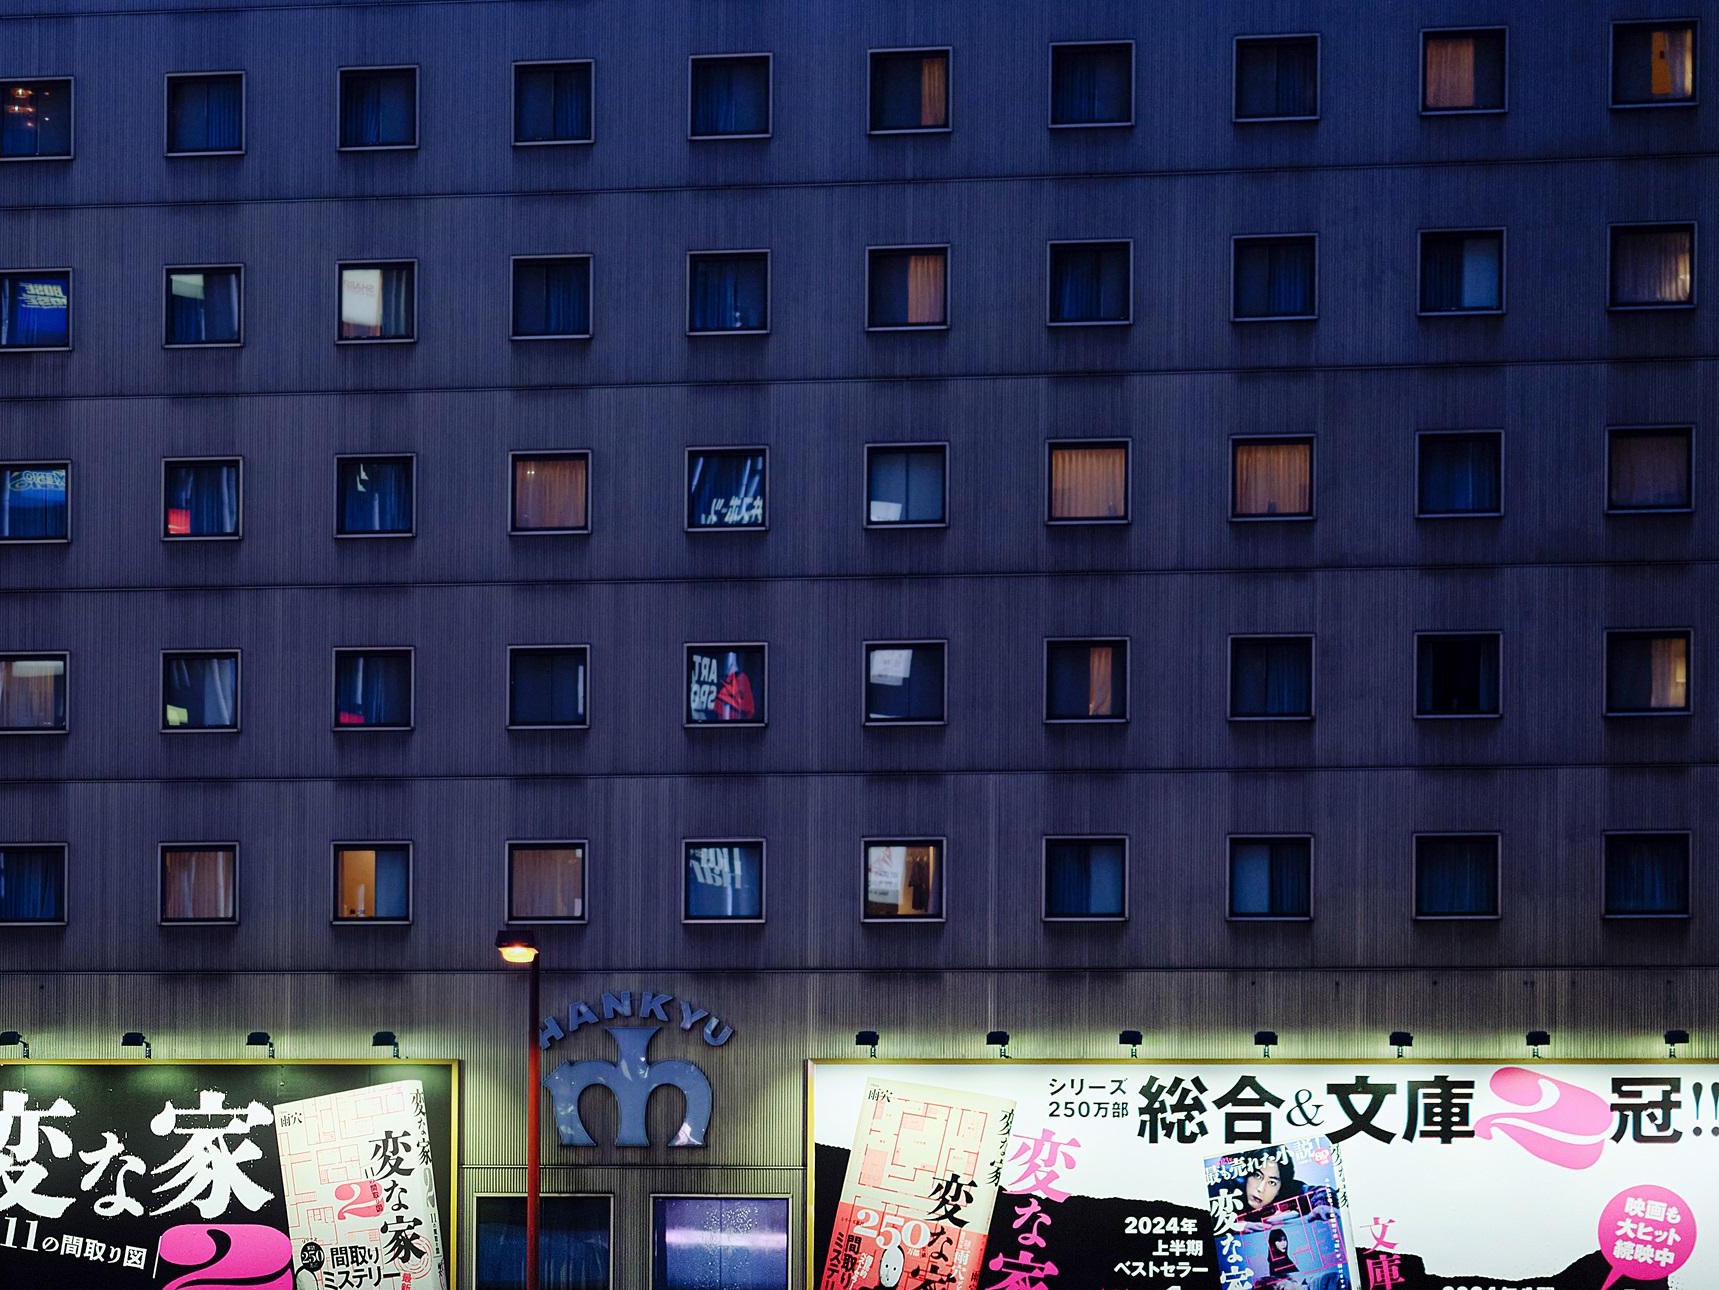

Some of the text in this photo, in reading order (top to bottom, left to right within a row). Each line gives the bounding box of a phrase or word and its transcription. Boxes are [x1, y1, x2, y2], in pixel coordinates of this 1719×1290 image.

[540, 991, 735, 1051] HANKYU
[867, 1088, 893, 1103] 雨穴
[1048, 1077, 1128, 1096] シリーズ
[1048, 1100, 1129, 1118] 250万部
[335, 1181, 384, 1221] 2
[368, 1131, 426, 1264] 変な家
[1624, 1197, 1681, 1224] 映画も
[853, 1208, 931, 1248] 250
[1124, 1216, 1198, 1236] 2024年
[1615, 1219, 1682, 1246] 大ヒット
[0, 1215, 147, 1271] 11の間取り図
[1152, 1239, 1203, 1257] 上半期
[1612, 1239, 1676, 1268] 続映中
[330, 1245, 379, 1269] 間取り
[840, 1234, 862, 1289] 間取り
[1113, 1261, 1208, 1278] ベストセラー
[323, 1266, 401, 1290] ミステリー
